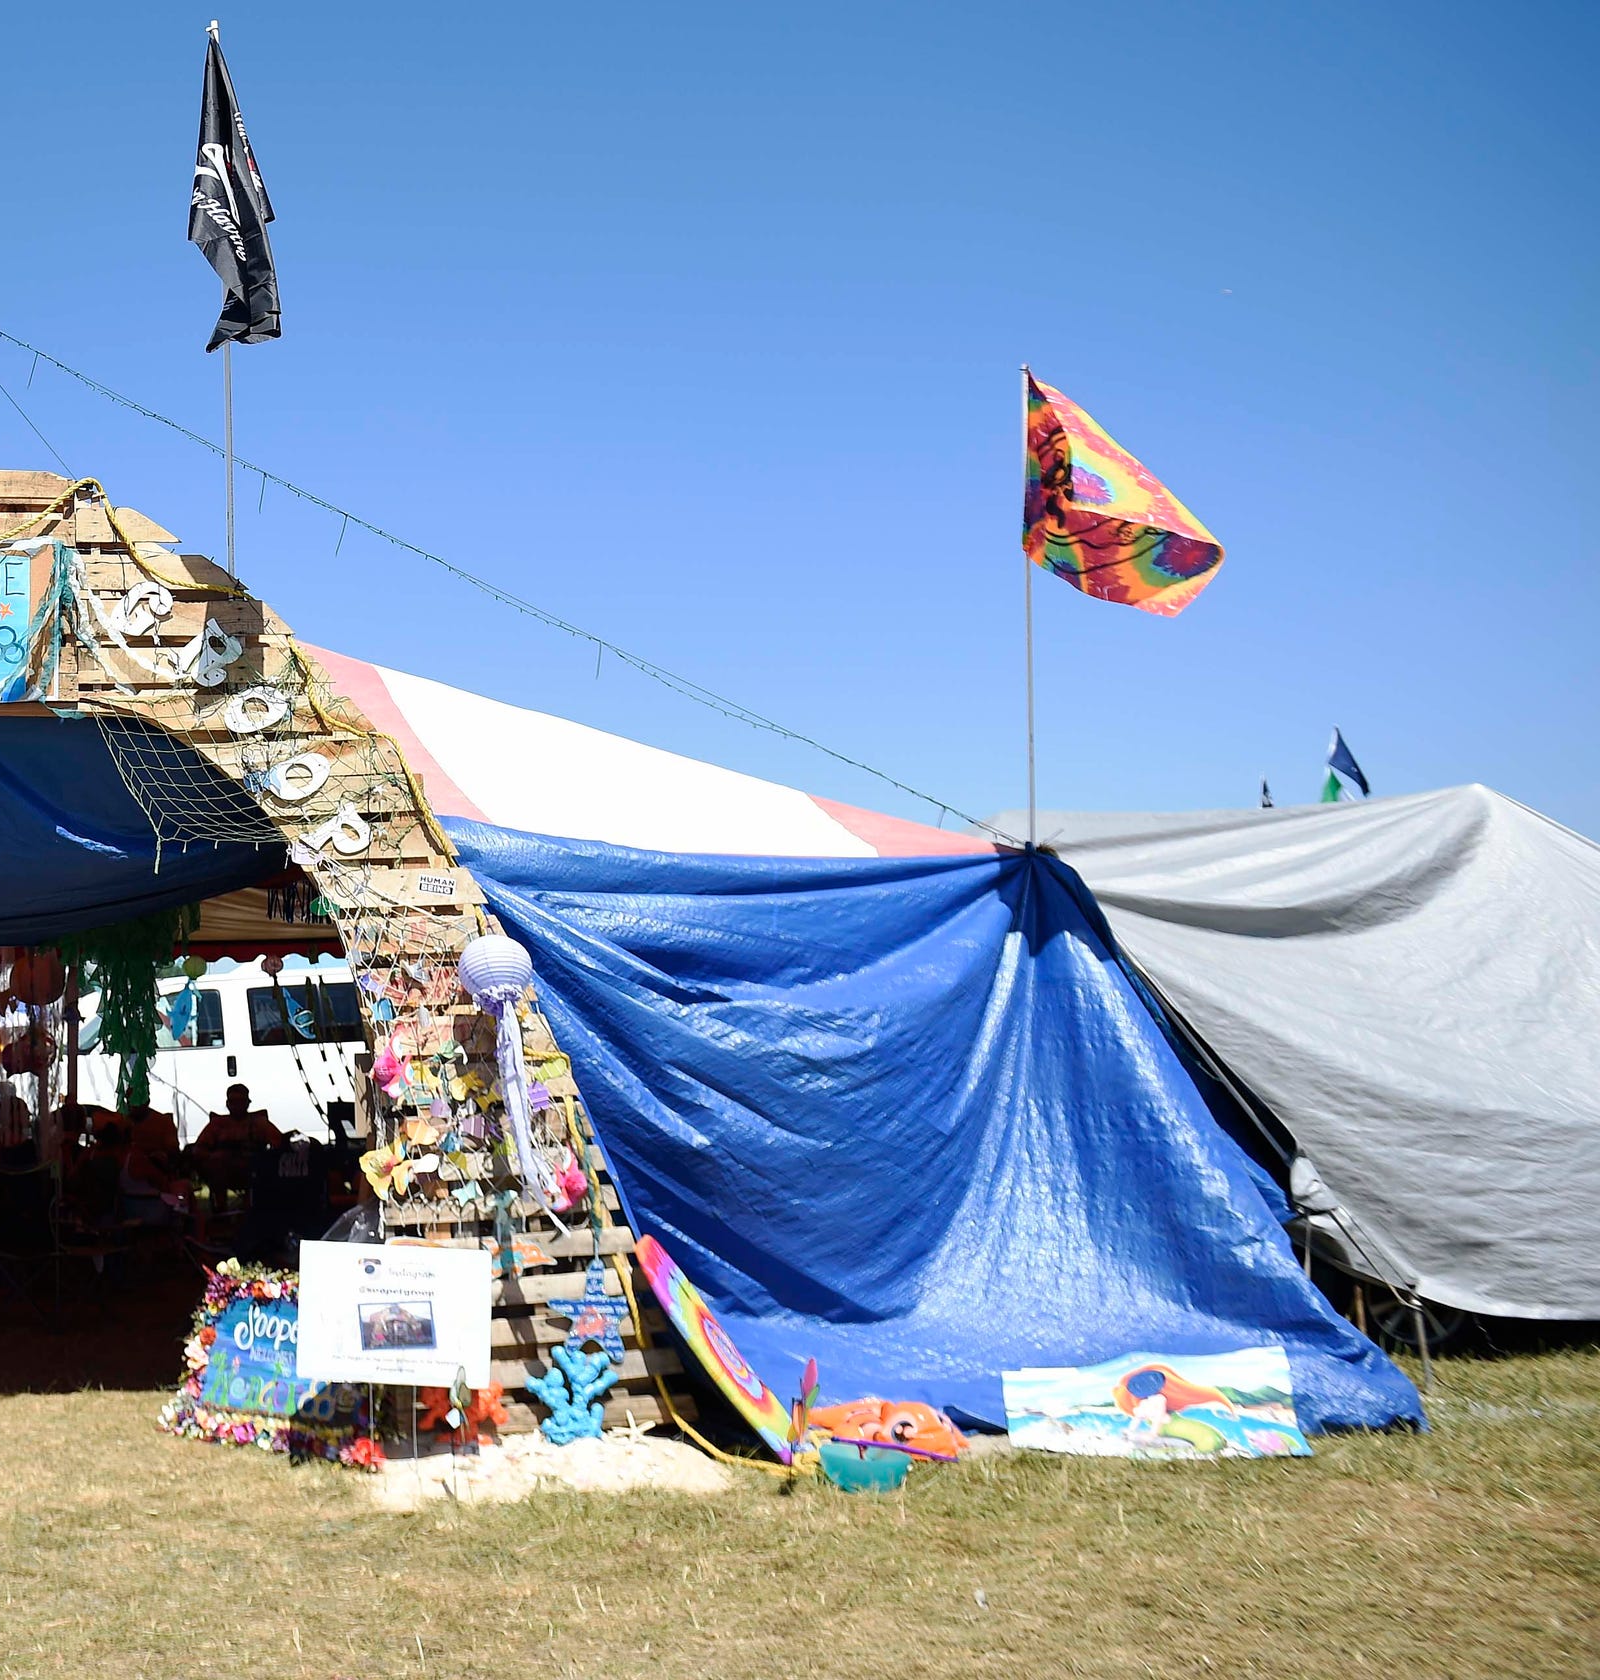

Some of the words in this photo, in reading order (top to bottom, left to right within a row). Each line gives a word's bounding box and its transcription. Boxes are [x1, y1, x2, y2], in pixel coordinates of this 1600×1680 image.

[420, 876, 454, 886] HUMAN
[420, 883, 453, 895] BEING
[234, 1303, 298, 1350] Soope
